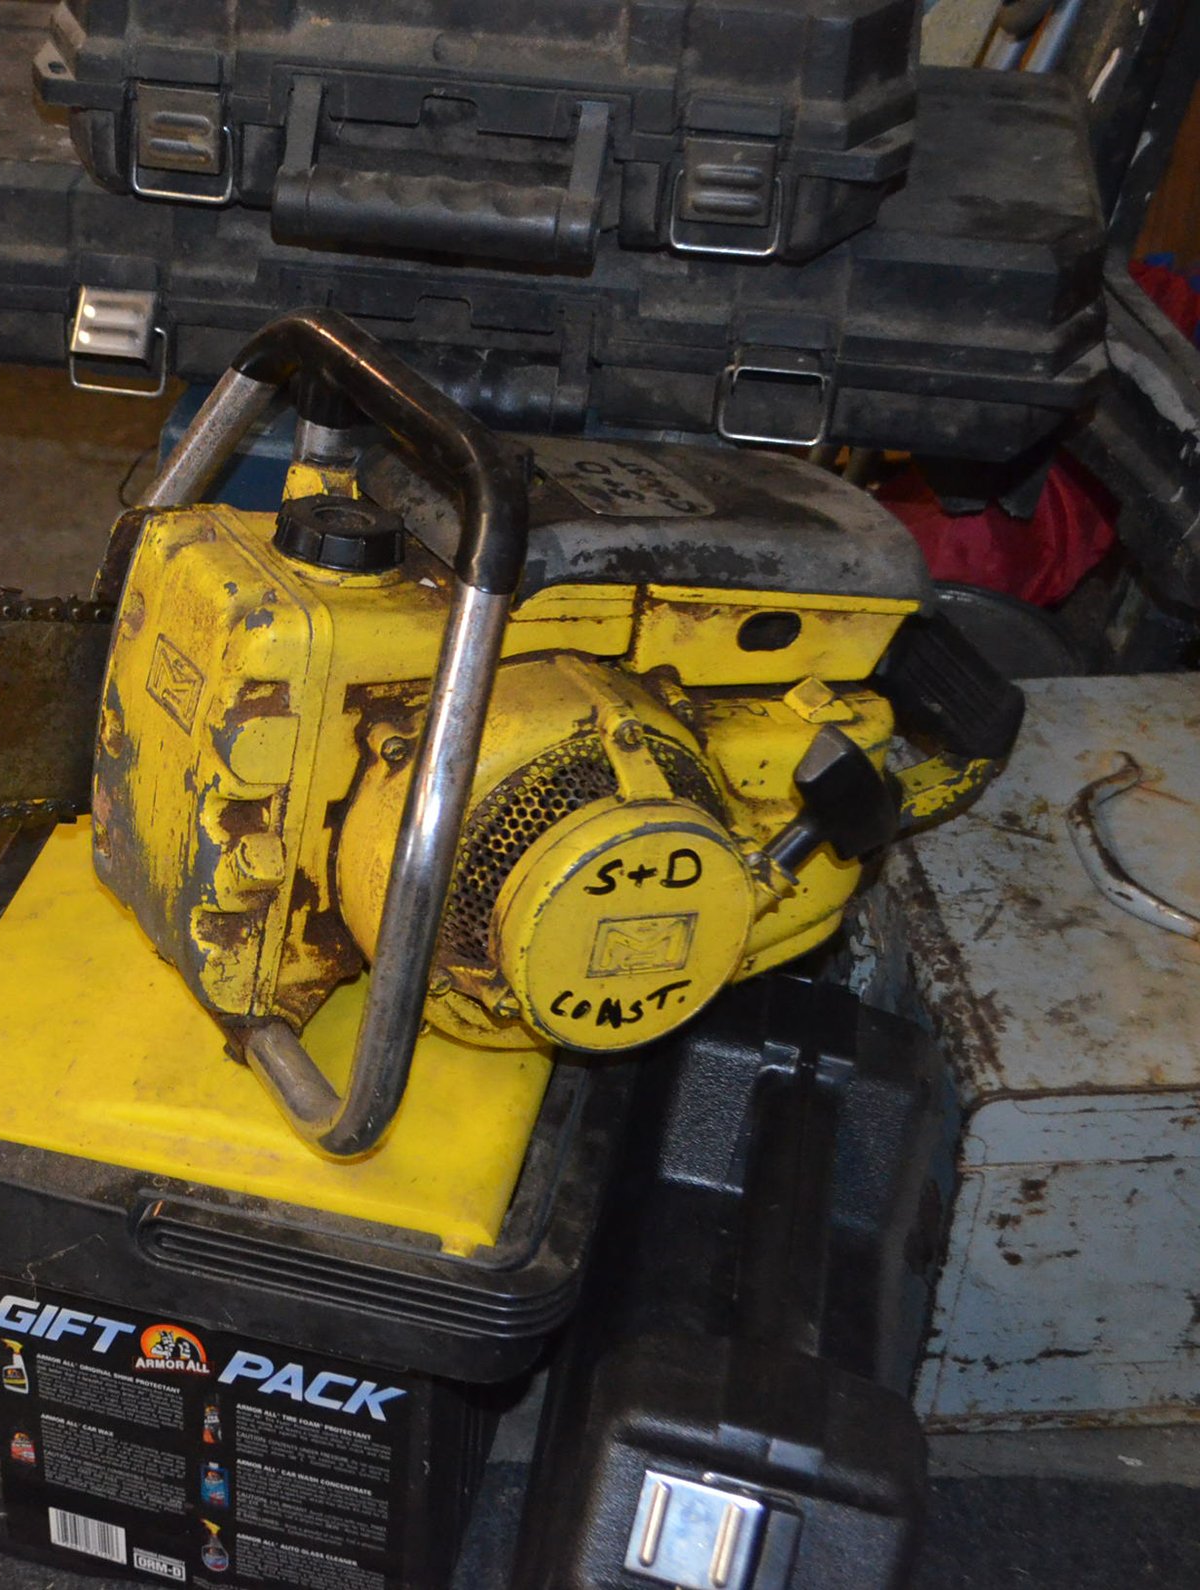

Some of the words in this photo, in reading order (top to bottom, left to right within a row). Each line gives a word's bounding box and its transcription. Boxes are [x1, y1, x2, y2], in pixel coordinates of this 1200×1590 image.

[36, 1353, 61, 1364] ARMOR
[135, 1378, 180, 1394] PROTECTANT
[135, 1357, 185, 1370] ARMOR
[186, 1359, 210, 1374] ALL
[217, 1350, 407, 1422] PACK
[40, 1413, 65, 1424] ARMOR
[236, 1403, 262, 1414] ARMOR
[324, 1424, 371, 1440] PROTECTANT
[236, 1459, 262, 1469] ARMOR
[320, 1479, 372, 1496] CONCENTRATE
[236, 1533, 261, 1543] ARMOR
[280, 1544, 300, 1553] AUTO
[138, 1556, 181, 1577] ORM-D
